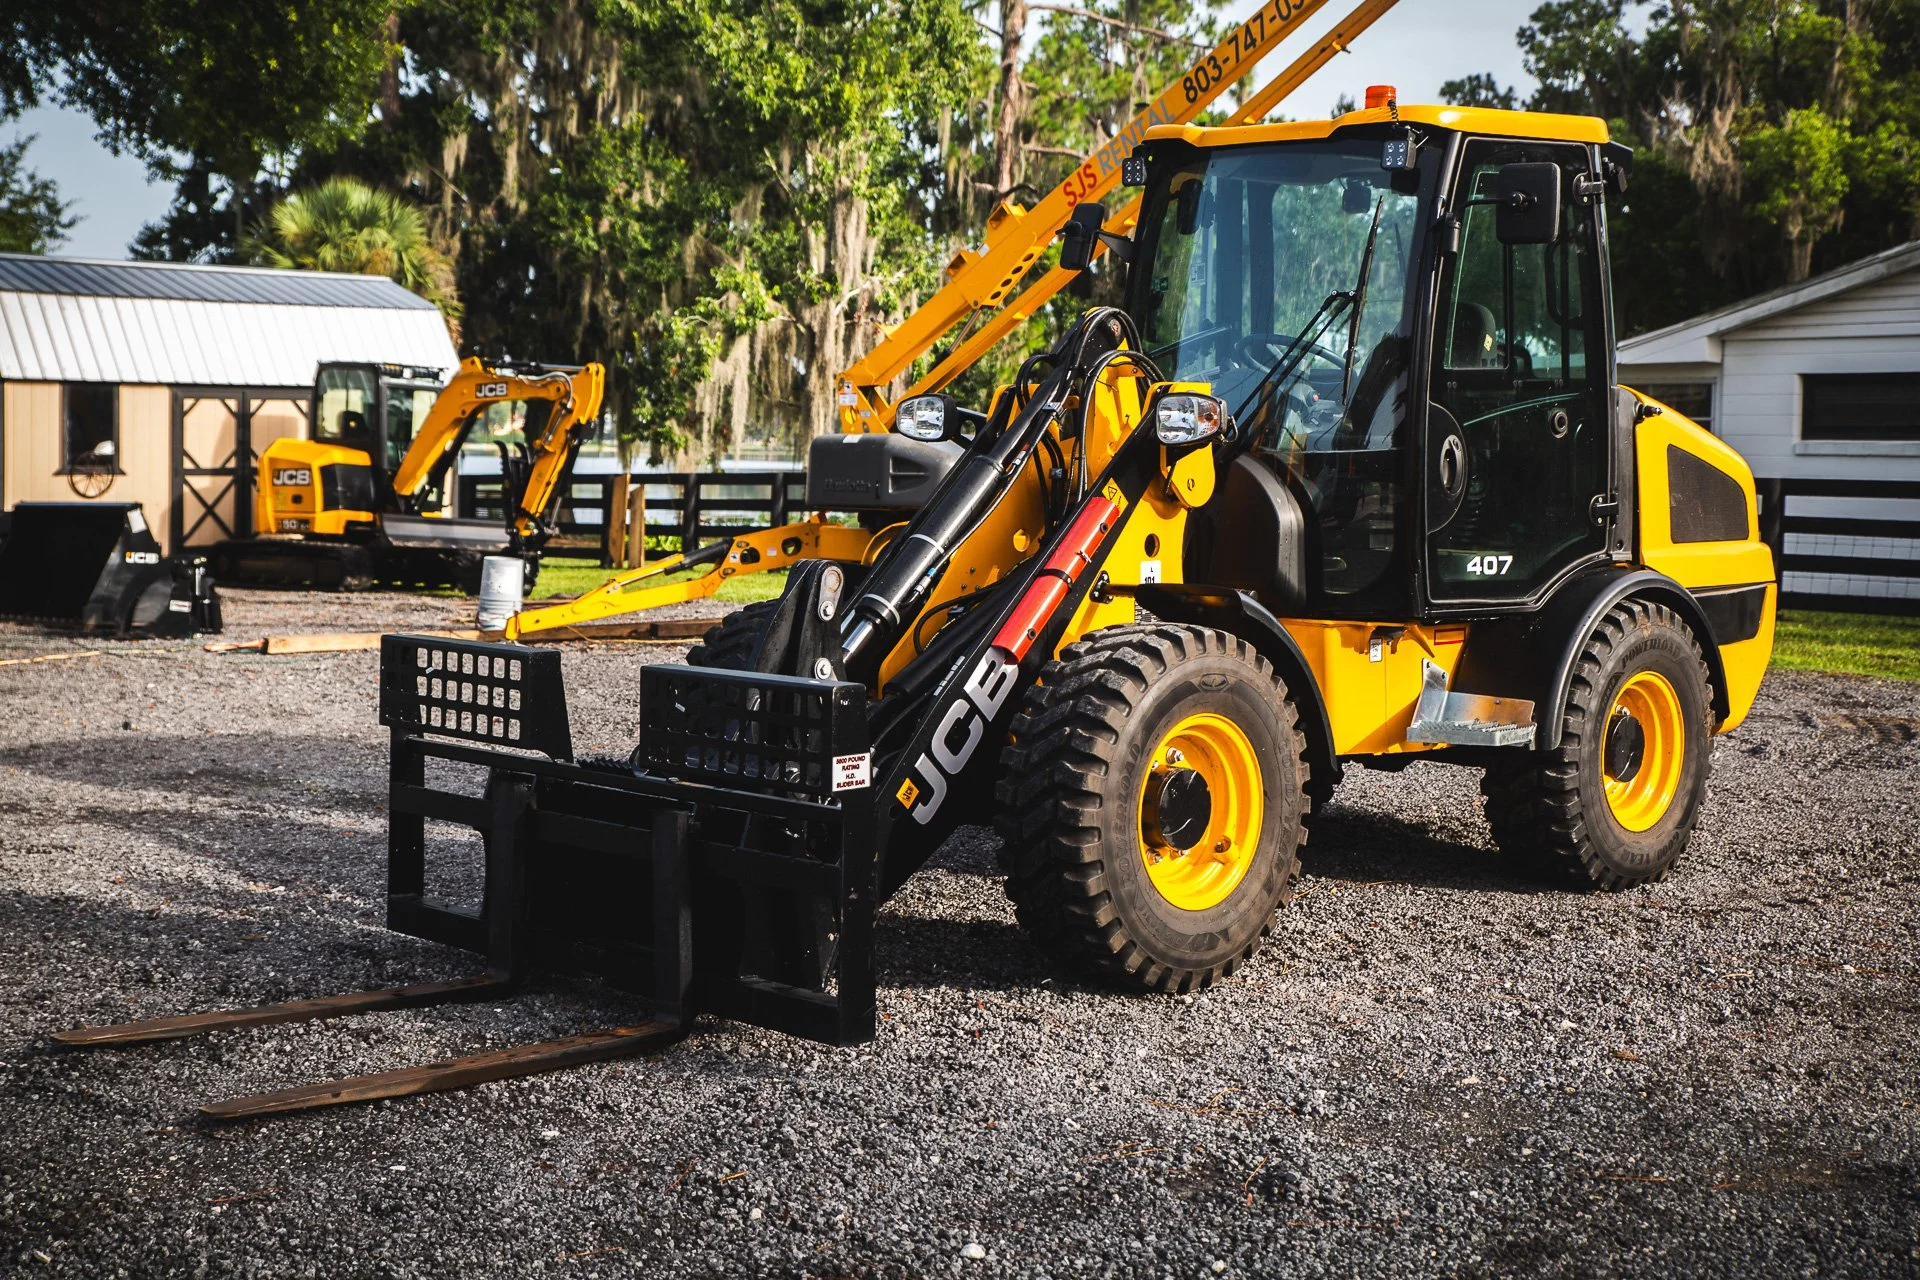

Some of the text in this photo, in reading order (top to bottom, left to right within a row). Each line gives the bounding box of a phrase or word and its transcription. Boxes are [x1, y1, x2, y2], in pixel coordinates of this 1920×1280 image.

[1063, 163, 1098, 208] SJS
[1096, 98, 1175, 177] RENTAL
[475, 383, 508, 398] JCB
[273, 469, 311, 485] JCB
[125, 551, 159, 565] JCB
[1466, 555, 1514, 576] 407
[911, 646, 1020, 825] JCB
[847, 755, 866, 763] POUND
[841, 763, 860, 772] RATING
[836, 779, 866, 789] SLIDER BAR
